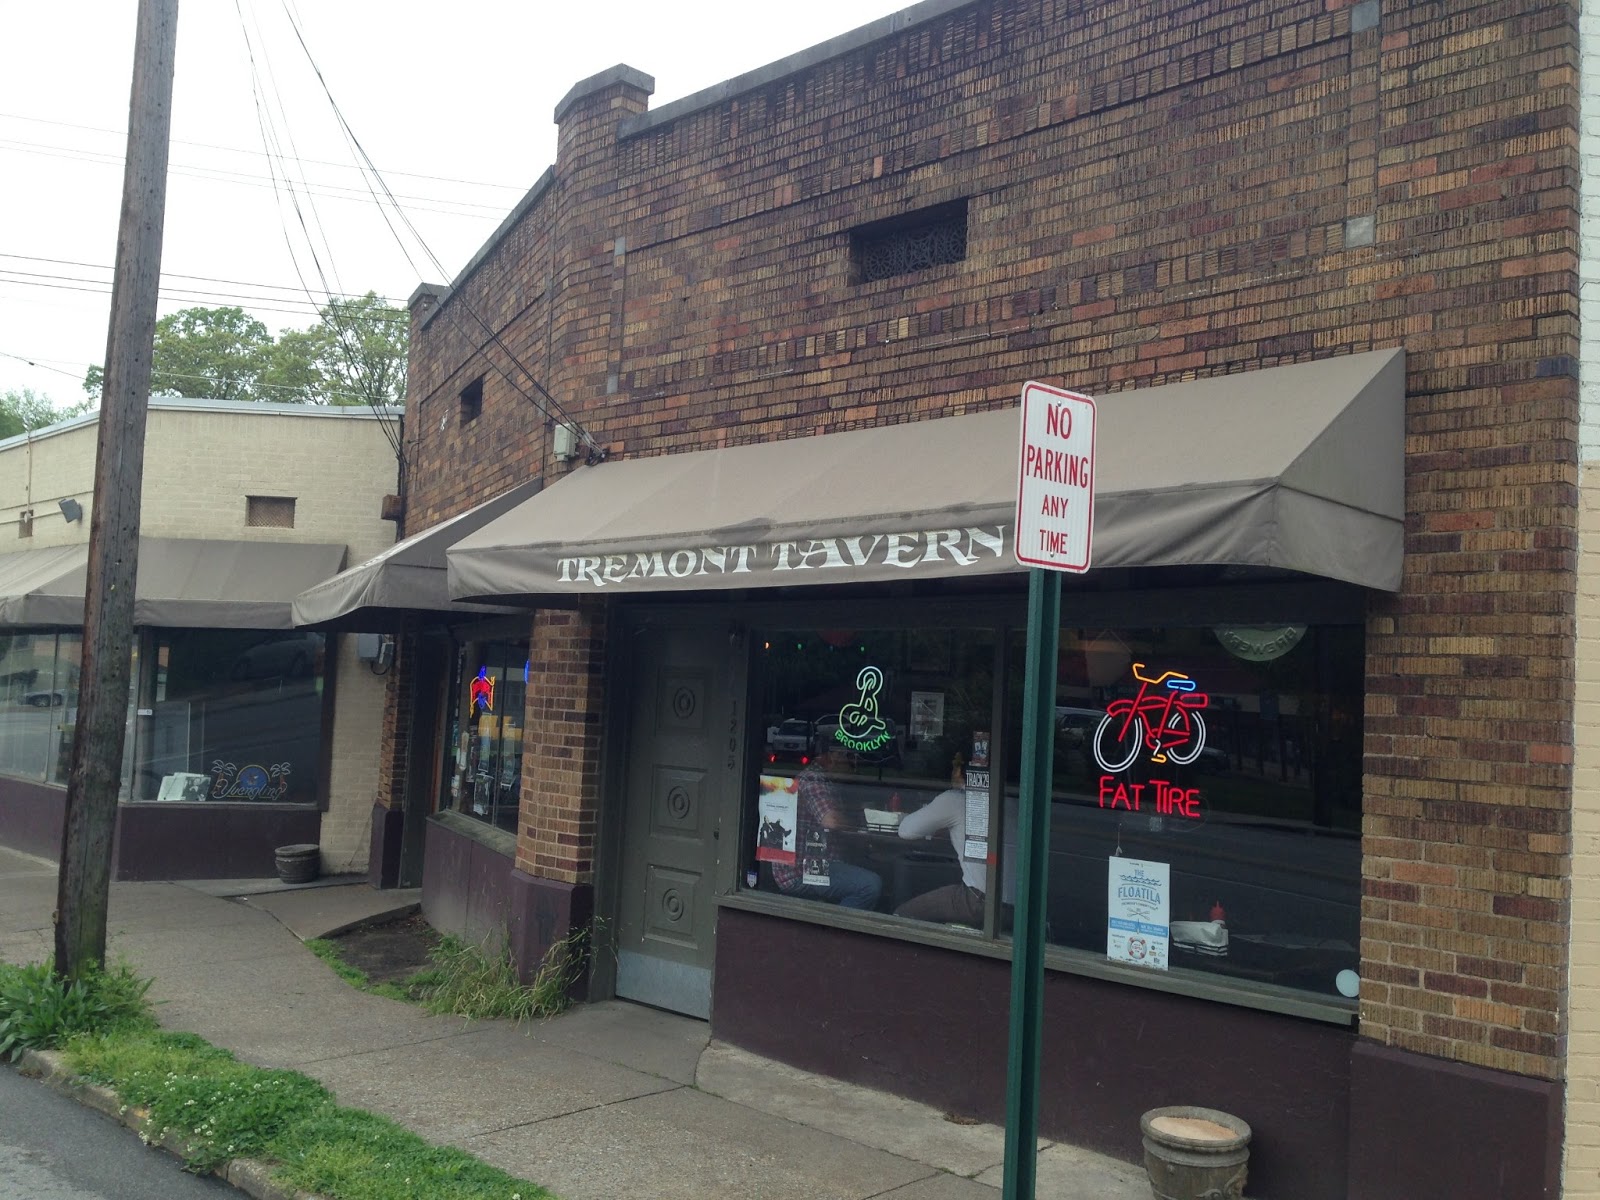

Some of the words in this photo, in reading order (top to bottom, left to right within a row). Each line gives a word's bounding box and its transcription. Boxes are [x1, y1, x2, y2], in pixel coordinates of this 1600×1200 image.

[1046, 403, 1073, 440] NO
[1026, 444, 1089, 489] PARKING
[1041, 494, 1069, 519] ANY
[1039, 529, 1068, 554] TIME
[556, 545, 757, 587] TREMONT
[769, 524, 1007, 571] TAVERN
[834, 729, 891, 751] BROOKLYN
[212, 778, 288, 800] Yuengling
[1099, 775, 1146, 811] FAT
[1149, 780, 1201, 817] TIRE
[1117, 885, 1161, 905] FLOATILA
